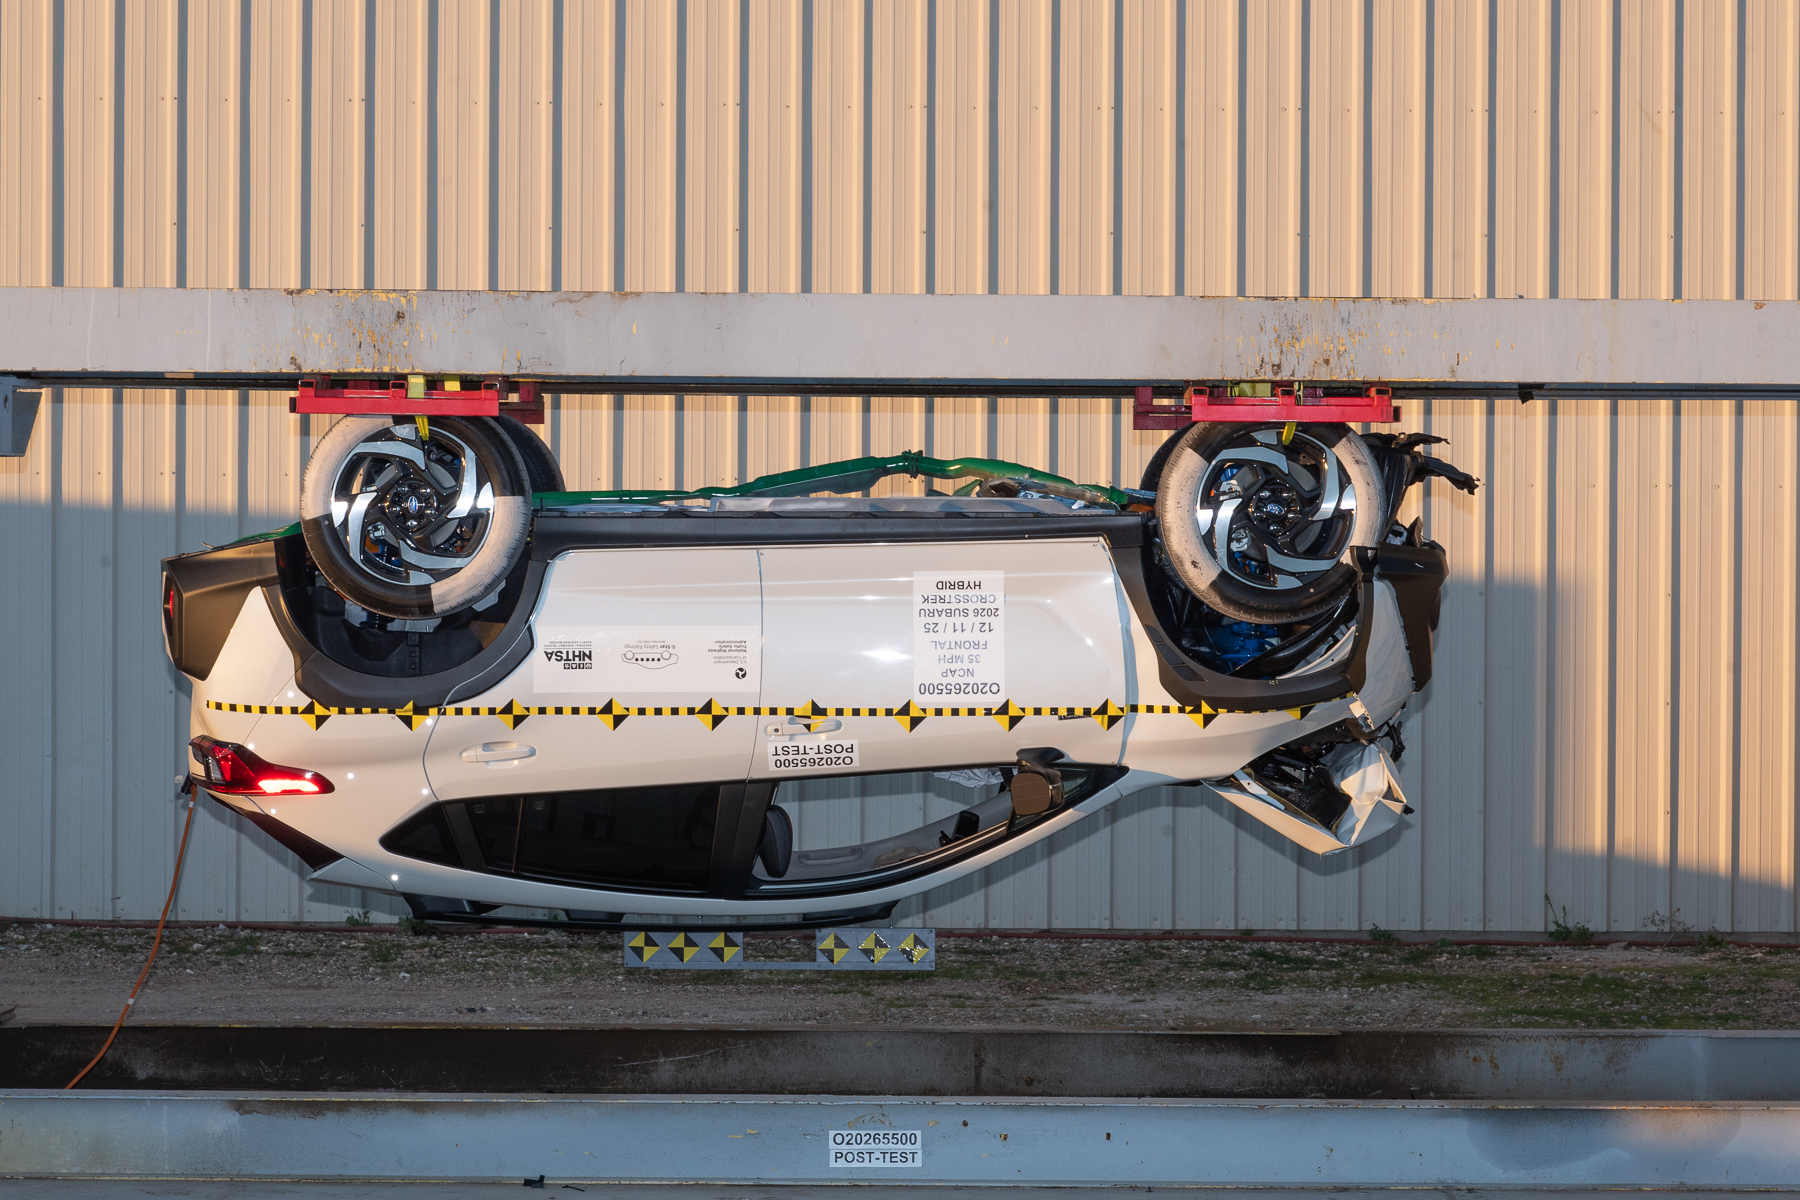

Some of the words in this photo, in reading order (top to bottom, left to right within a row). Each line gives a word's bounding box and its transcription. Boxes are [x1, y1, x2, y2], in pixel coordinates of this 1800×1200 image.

[936, 581, 981, 590] HYBRID
[921, 594, 996, 604] CROSSTREK
[919, 608, 969, 617] SUBARU
[973, 608, 999, 617] 2026
[923, 622, 939, 633] 25
[952, 622, 966, 633] 11
[979, 622, 994, 633] 12
[931, 640, 987, 650] FRONTAL
[544, 650, 592, 662] NHTSA
[938, 654, 964, 663] MPH
[968, 654, 980, 663] 35
[941, 668, 974, 677] NCAP
[918, 682, 1000, 695] O20265500
[772, 744, 854, 756] POST-TEST
[774, 756, 853, 768] O20265500
[833, 1133, 917, 1145] O20265500
[835, 1152, 918, 1163] POST-TEST
